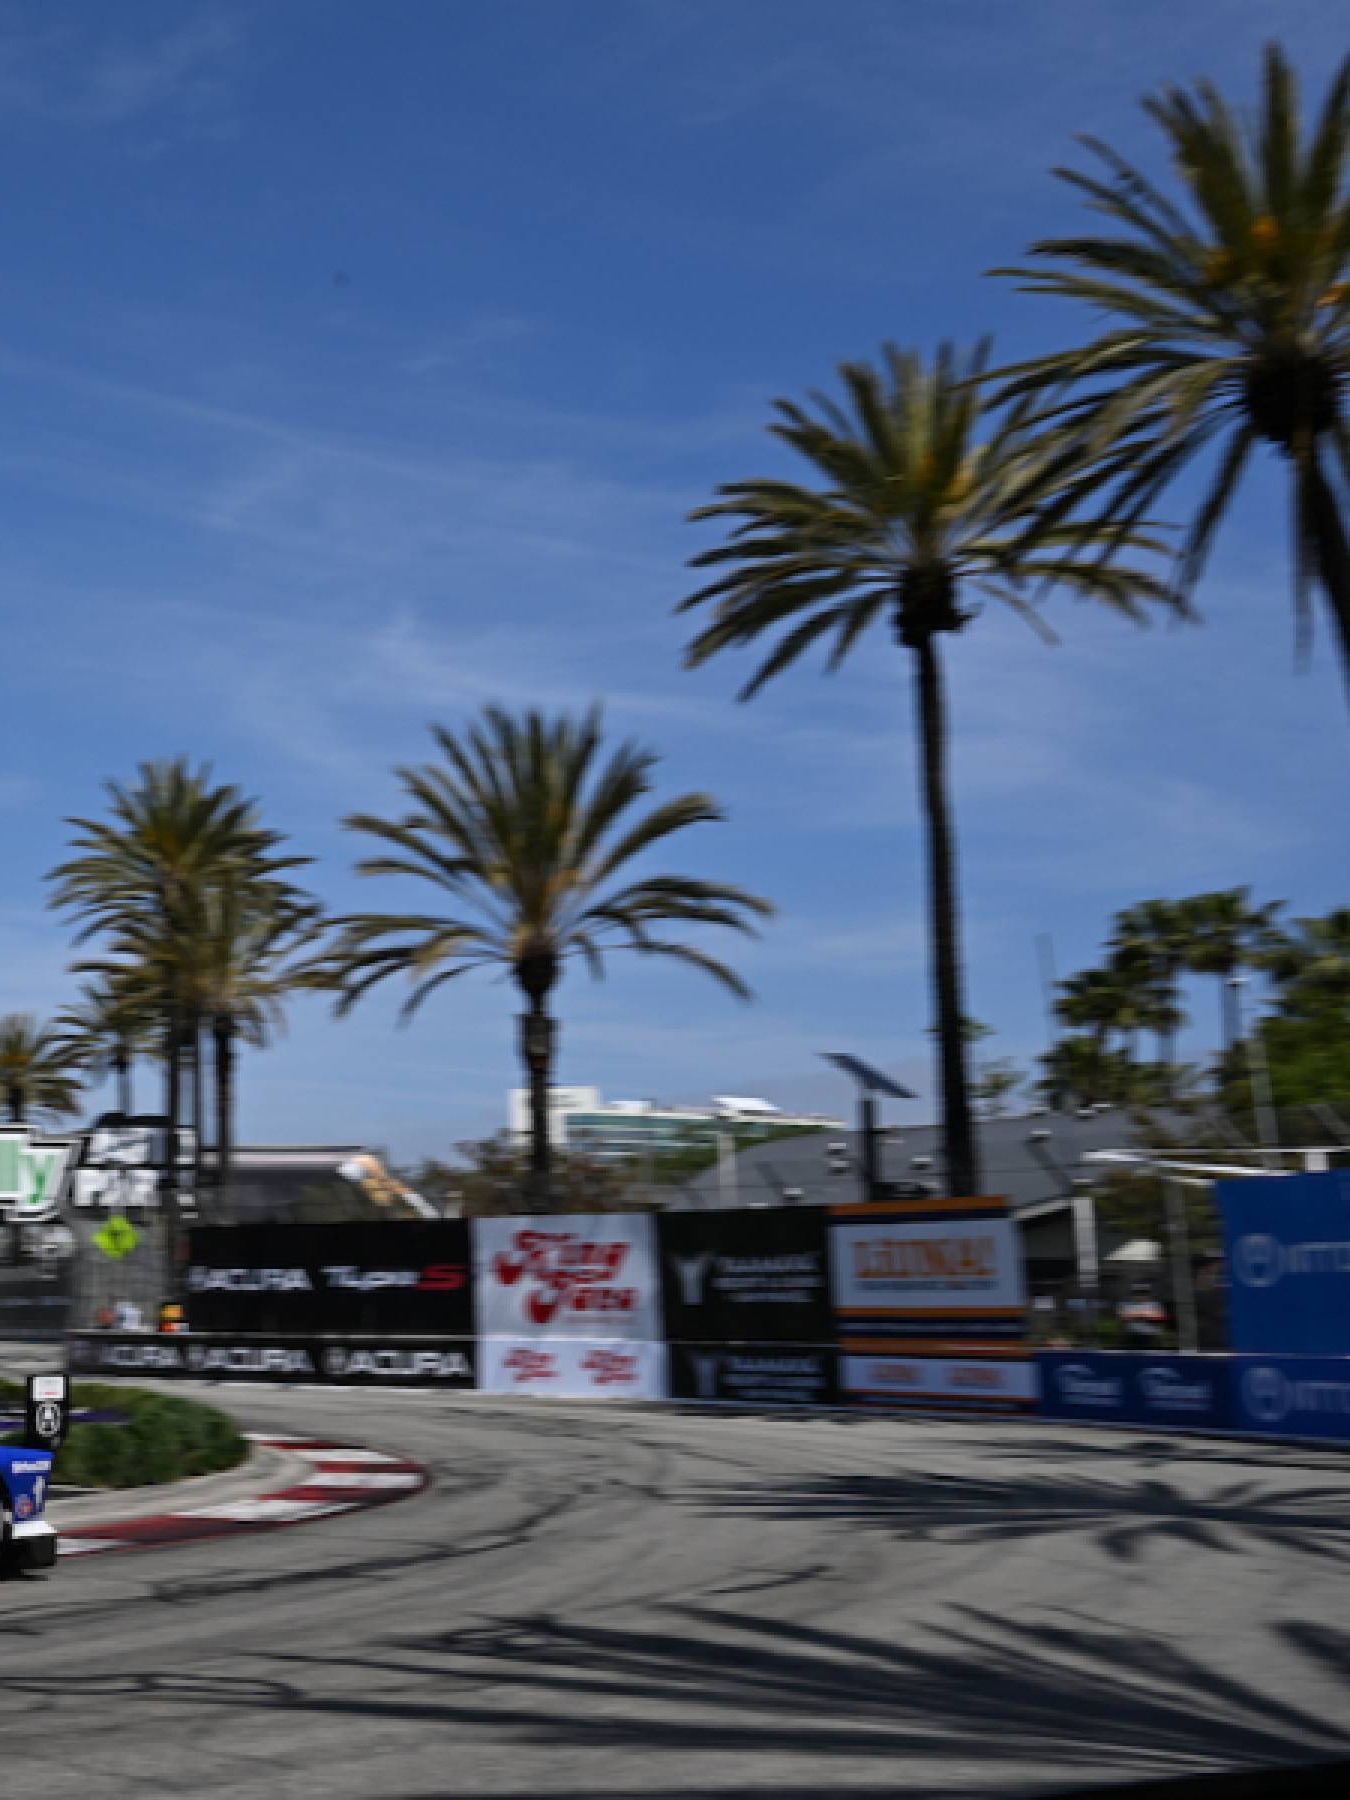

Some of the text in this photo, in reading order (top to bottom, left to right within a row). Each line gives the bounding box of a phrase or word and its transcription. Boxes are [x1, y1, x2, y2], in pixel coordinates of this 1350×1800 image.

[205, 1268, 313, 1291] ACURA
[414, 1264, 466, 1291] S
[205, 1347, 314, 1371] ACURA
[351, 1350, 469, 1377] ACURA
